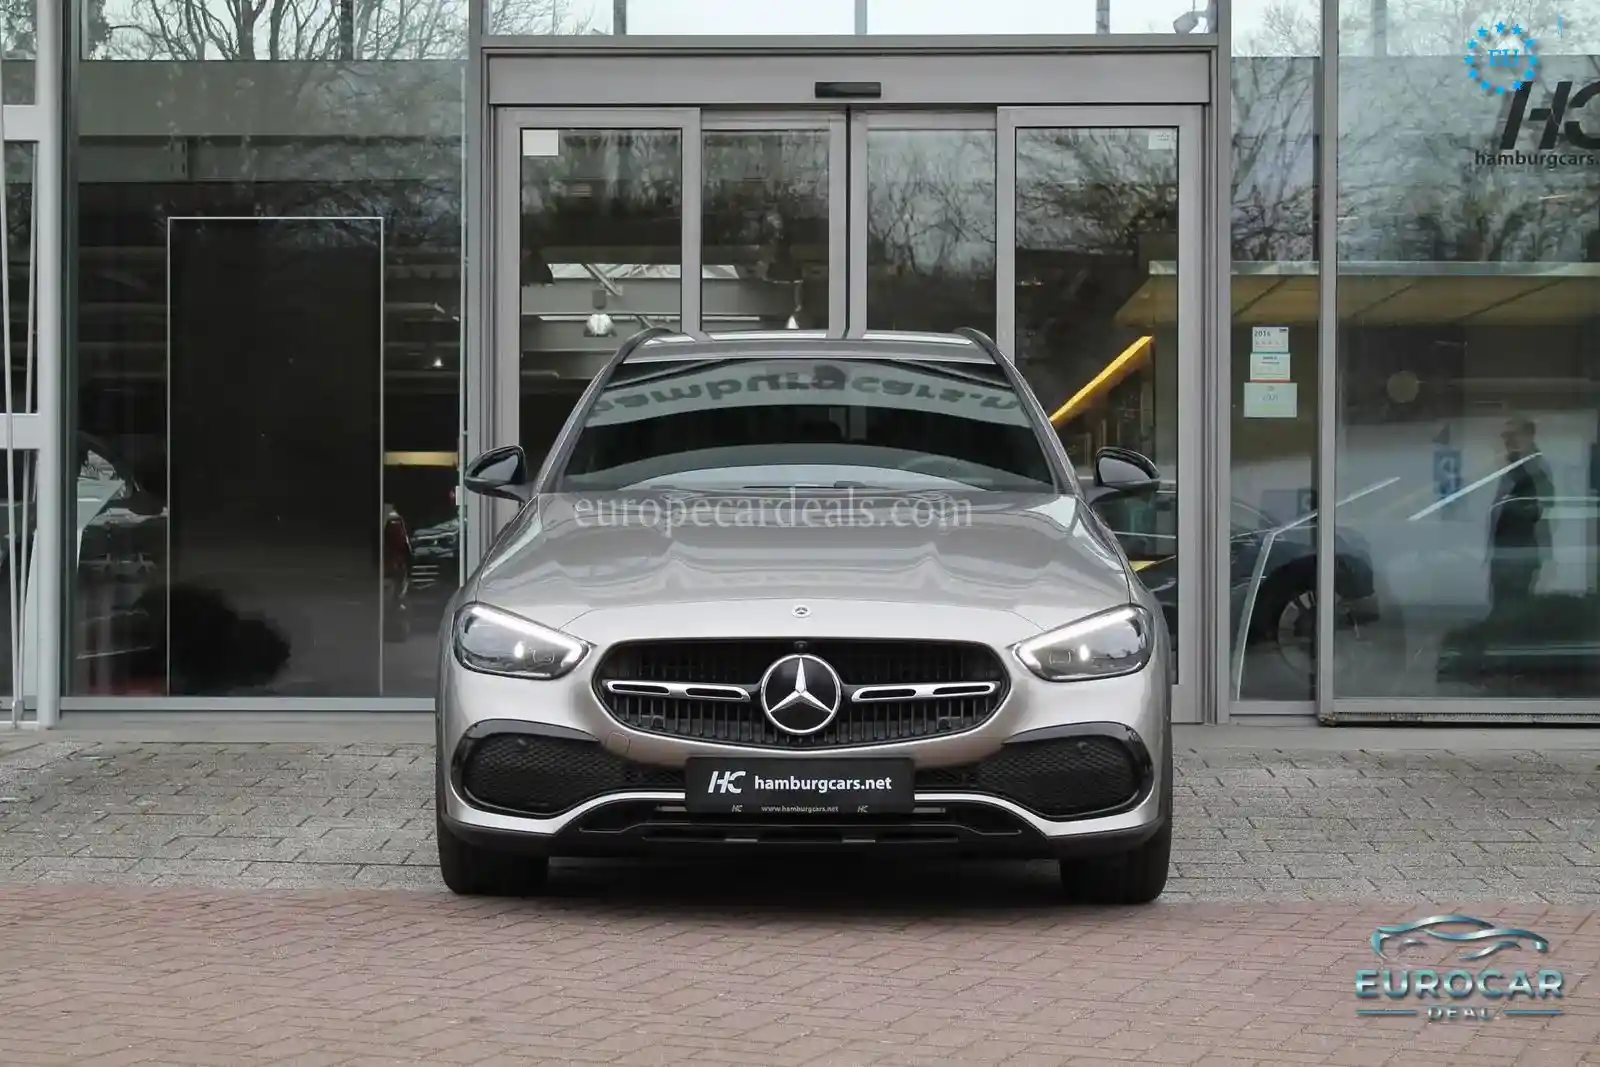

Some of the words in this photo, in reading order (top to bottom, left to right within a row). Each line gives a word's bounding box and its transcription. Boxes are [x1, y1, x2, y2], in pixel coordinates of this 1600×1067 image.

[1500, 80, 1600, 150] HC
[707, 770, 747, 794] HC
[754, 775, 893, 794] hamburgcars.net
[761, 804, 839, 814] www.hamburgcars.net
